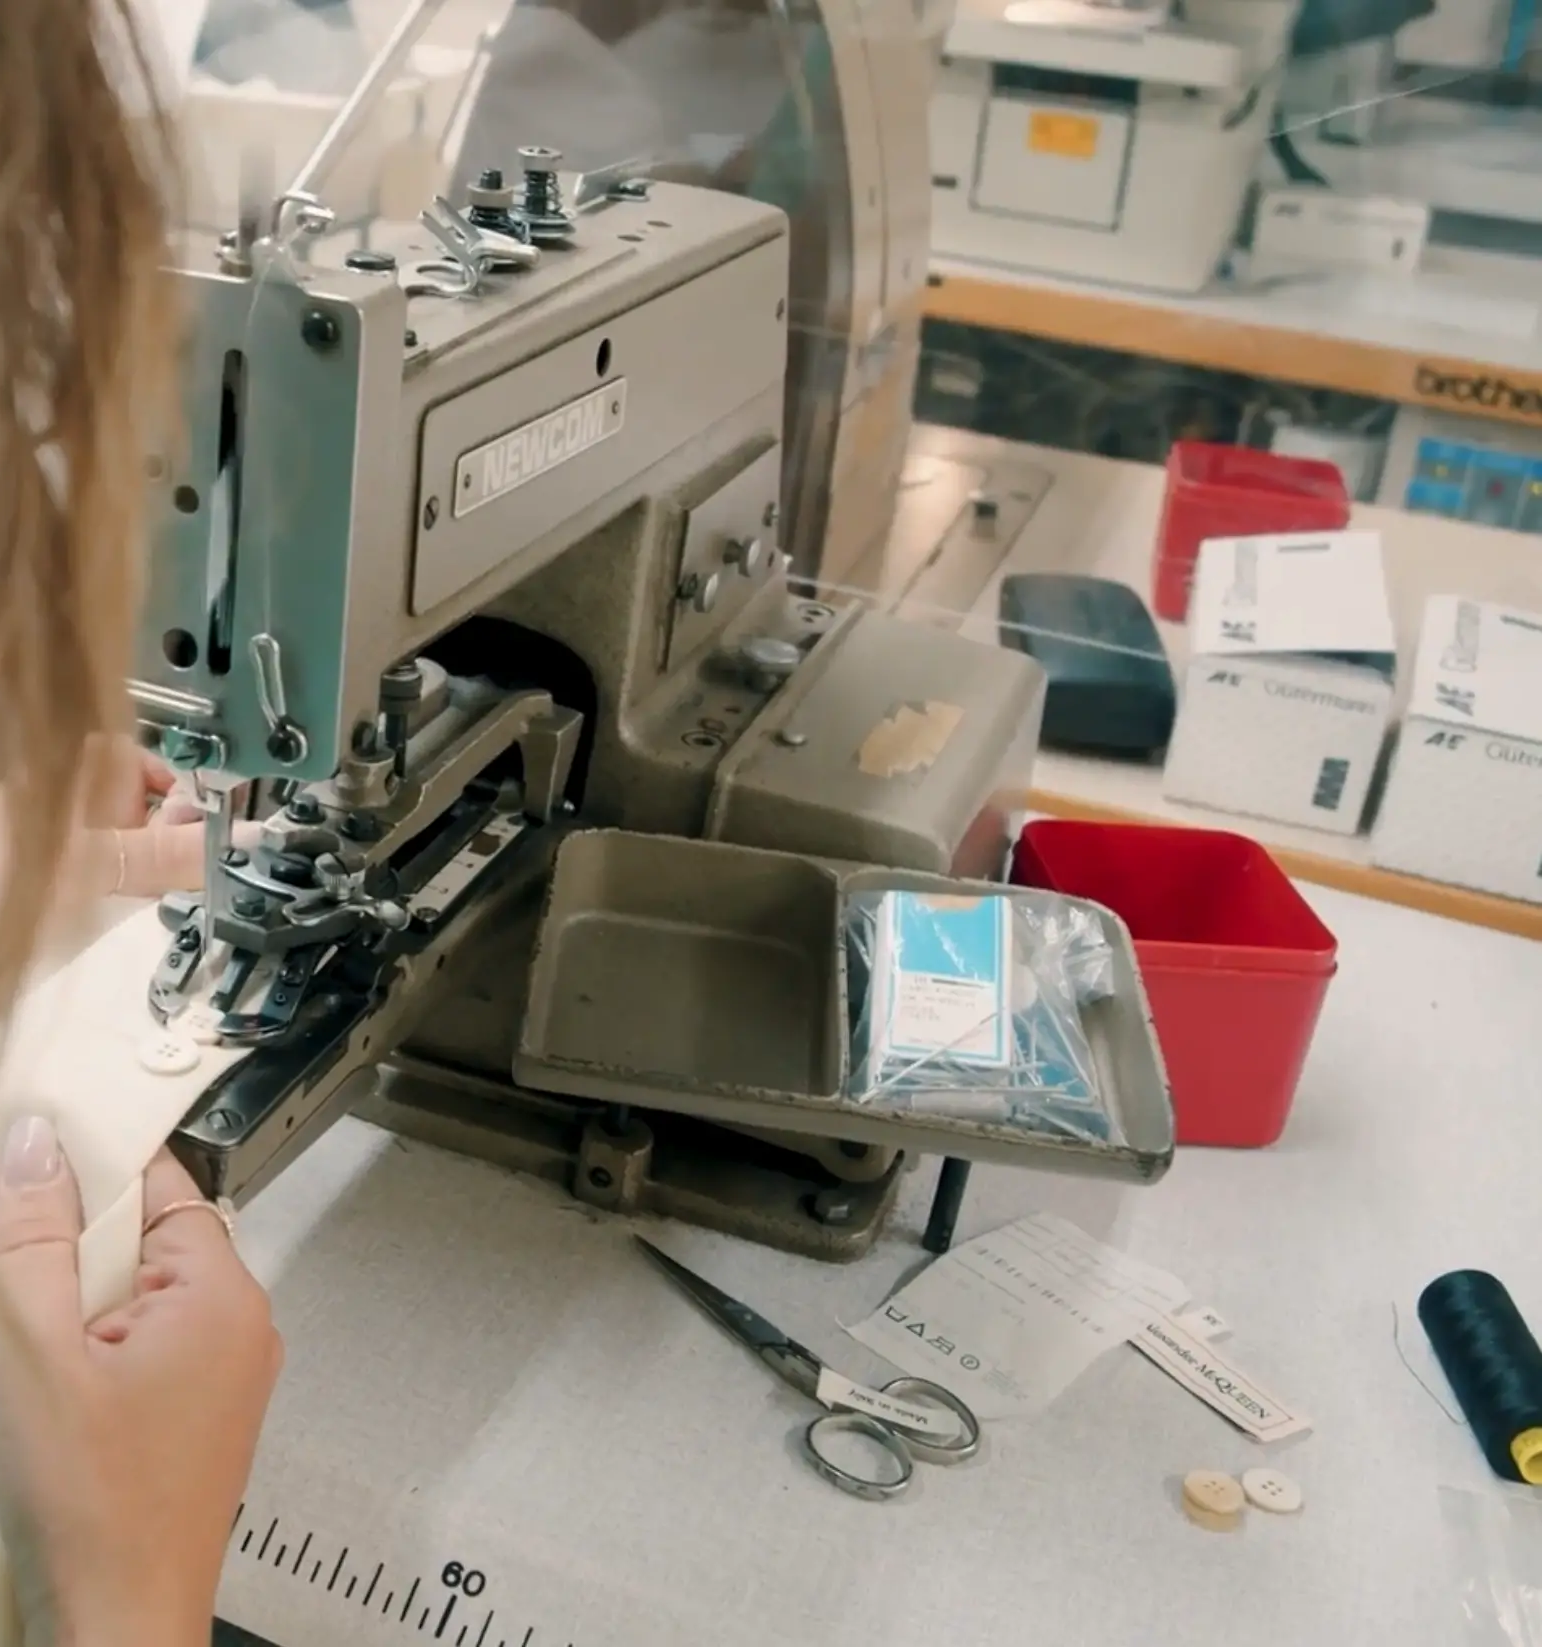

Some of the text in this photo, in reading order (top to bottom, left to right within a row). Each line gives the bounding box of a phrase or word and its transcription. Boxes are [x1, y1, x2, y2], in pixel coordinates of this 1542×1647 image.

[481, 394, 606, 496] NEWCOM
[1195, 1363, 1272, 1420] McQUEEN
[441, 1560, 486, 1597] 60
